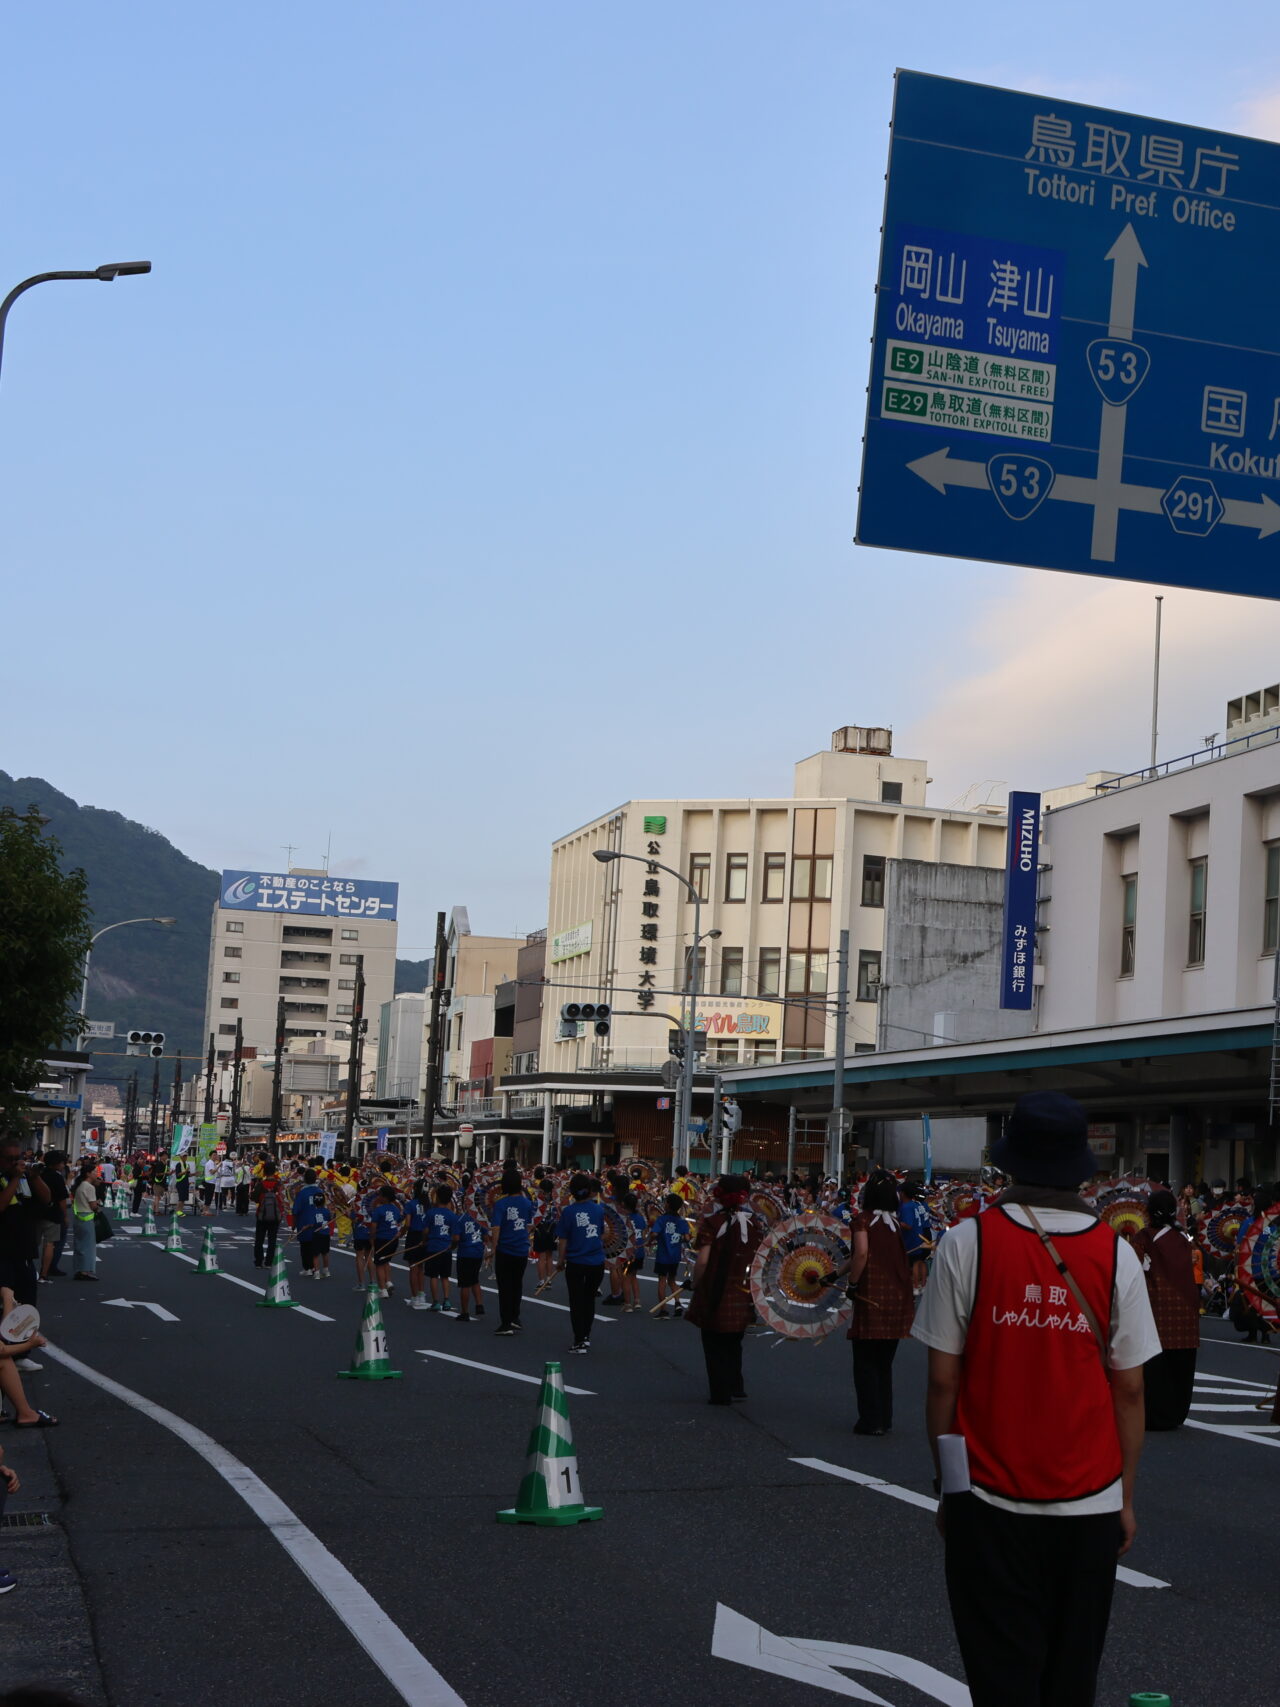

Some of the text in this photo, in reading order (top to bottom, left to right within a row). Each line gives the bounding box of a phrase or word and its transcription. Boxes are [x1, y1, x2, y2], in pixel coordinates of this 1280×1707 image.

[1025, 113, 1240, 198] 鳥取県庁
[1024, 168, 1236, 233] Tottori Pref. Office
[900, 245, 1054, 320] 岡山 津山
[896, 302, 1050, 355] Okayama Tsuyama
[895, 352, 920, 370] E9
[1097, 347, 1138, 385] 53
[927, 370, 964, 385] SAN-IN
[1020, 384, 1049, 398] FREE)
[888, 392, 924, 412] E29
[929, 412, 969, 427] TOTTORI
[1021, 425, 1049, 440] FREE)
[999, 463, 1041, 500] 53
[1172, 489, 1215, 523] 291
[1020, 808, 1035, 872] MIZUHO
[260, 875, 356, 893] 不動産のことなら
[256, 888, 394, 915] エステートセンター
[1012, 924, 1028, 993] みずほ銀行
[1023, 1284, 1067, 1306] 鳥取
[992, 1305, 1092, 1333] しゃんしゃん祭
